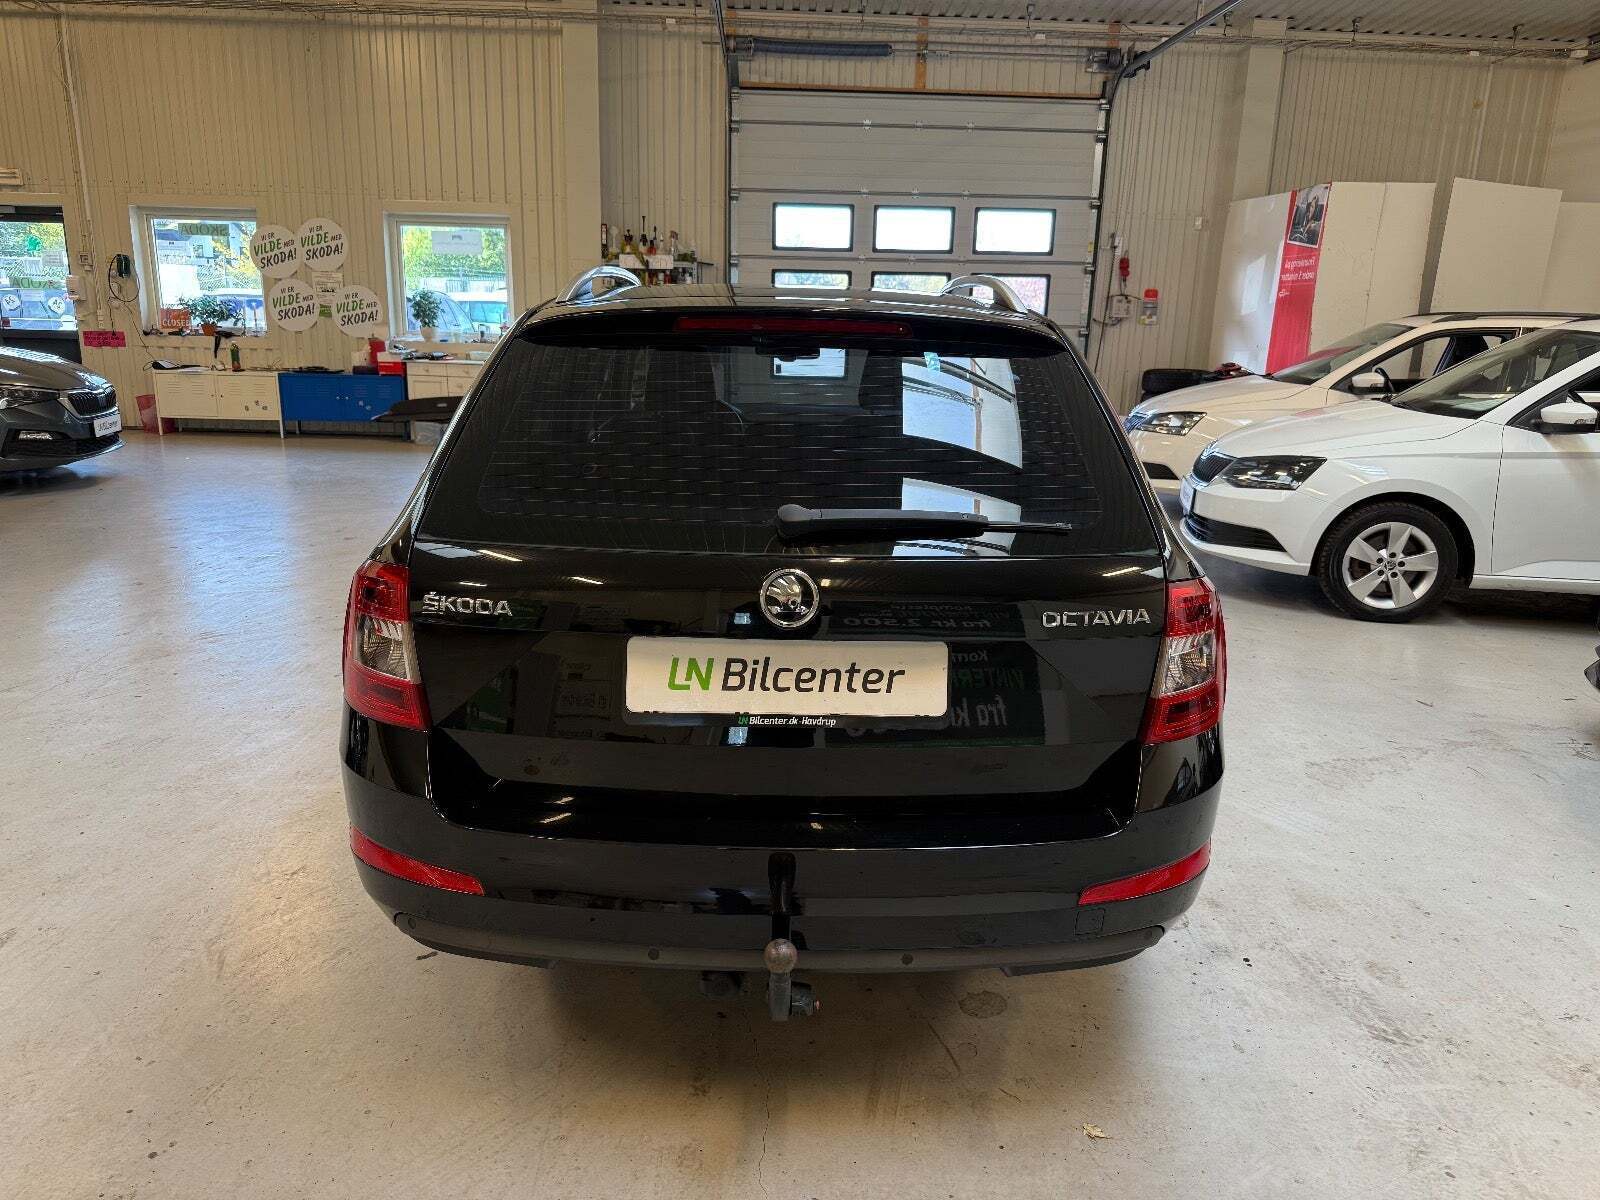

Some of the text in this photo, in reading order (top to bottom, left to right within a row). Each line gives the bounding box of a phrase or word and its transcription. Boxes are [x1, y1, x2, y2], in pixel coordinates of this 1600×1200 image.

[254, 238, 282, 256] VILDE
[301, 232, 329, 248] VILDE
[260, 248, 297, 269] SKODA!
[305, 243, 344, 260] SKODA!
[272, 292, 301, 309] VILDE
[336, 299, 364, 314] VILDE
[278, 303, 315, 321] SKODA!
[340, 310, 379, 327] SKODA!
[1042, 608, 1151, 628] OCTAVIA
[721, 656, 906, 694] Bilcenter
[801, 716, 836, 727] Havdrup
